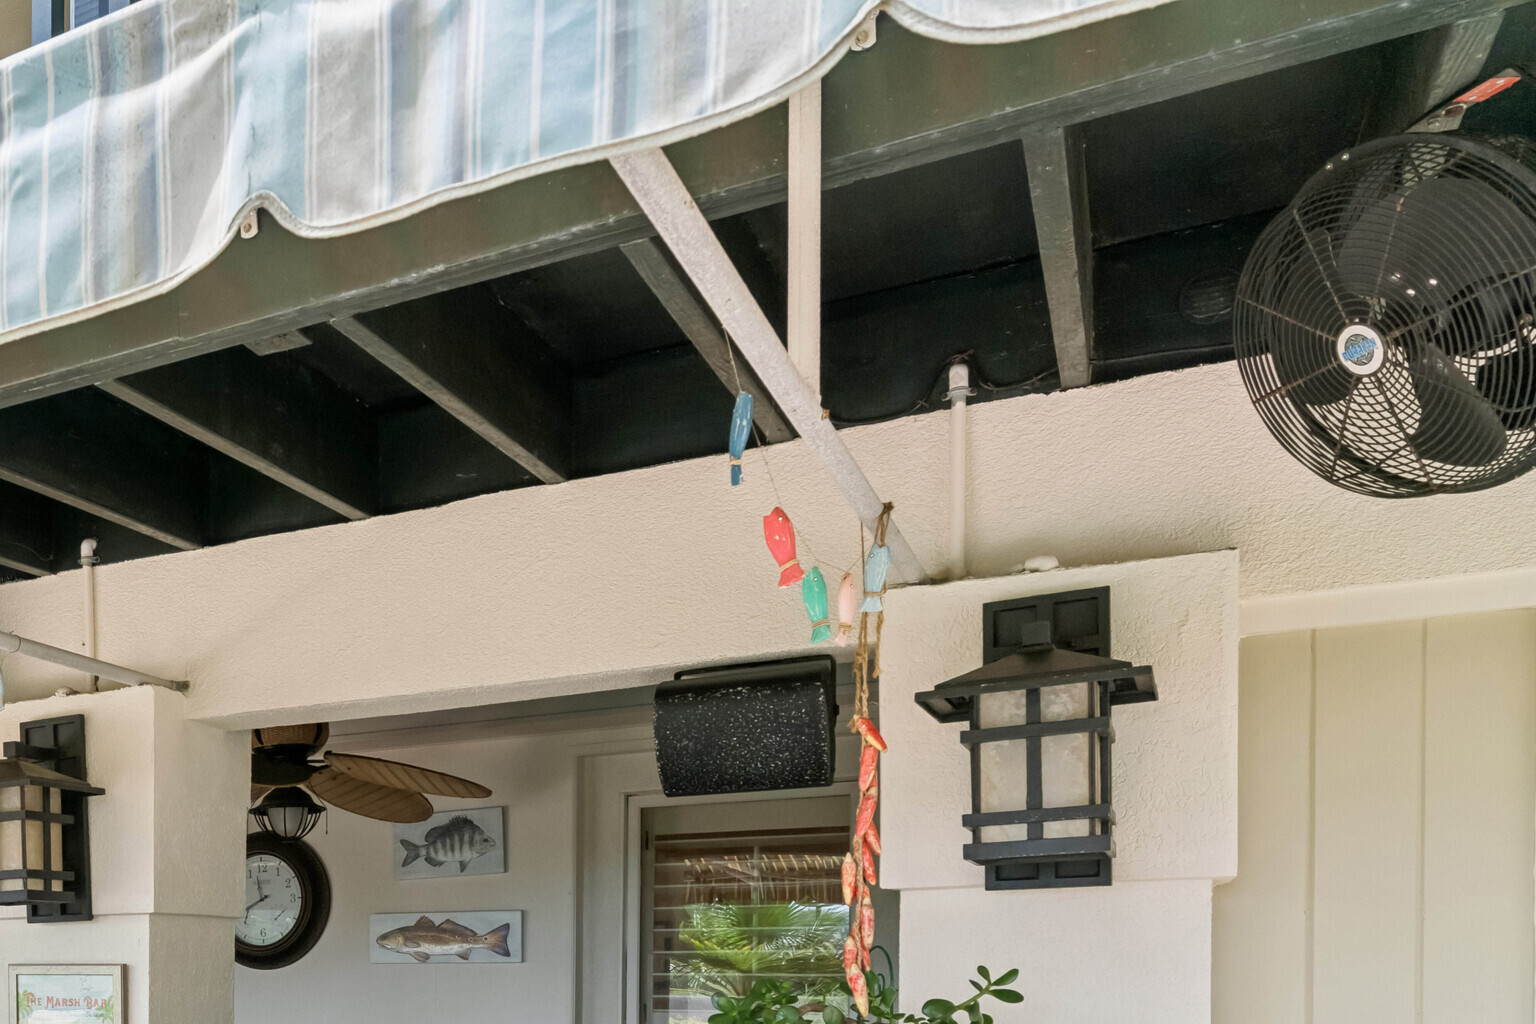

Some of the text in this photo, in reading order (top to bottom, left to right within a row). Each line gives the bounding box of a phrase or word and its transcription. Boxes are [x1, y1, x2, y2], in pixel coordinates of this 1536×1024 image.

[257, 864, 268, 873] 12
[276, 867, 281, 877] 1
[285, 878, 291, 888] 2
[290, 893, 297, 903] 3
[260, 928, 267, 938] 6
[44, 995, 81, 1009] MARSH
[83, 996, 107, 1010] BAR
